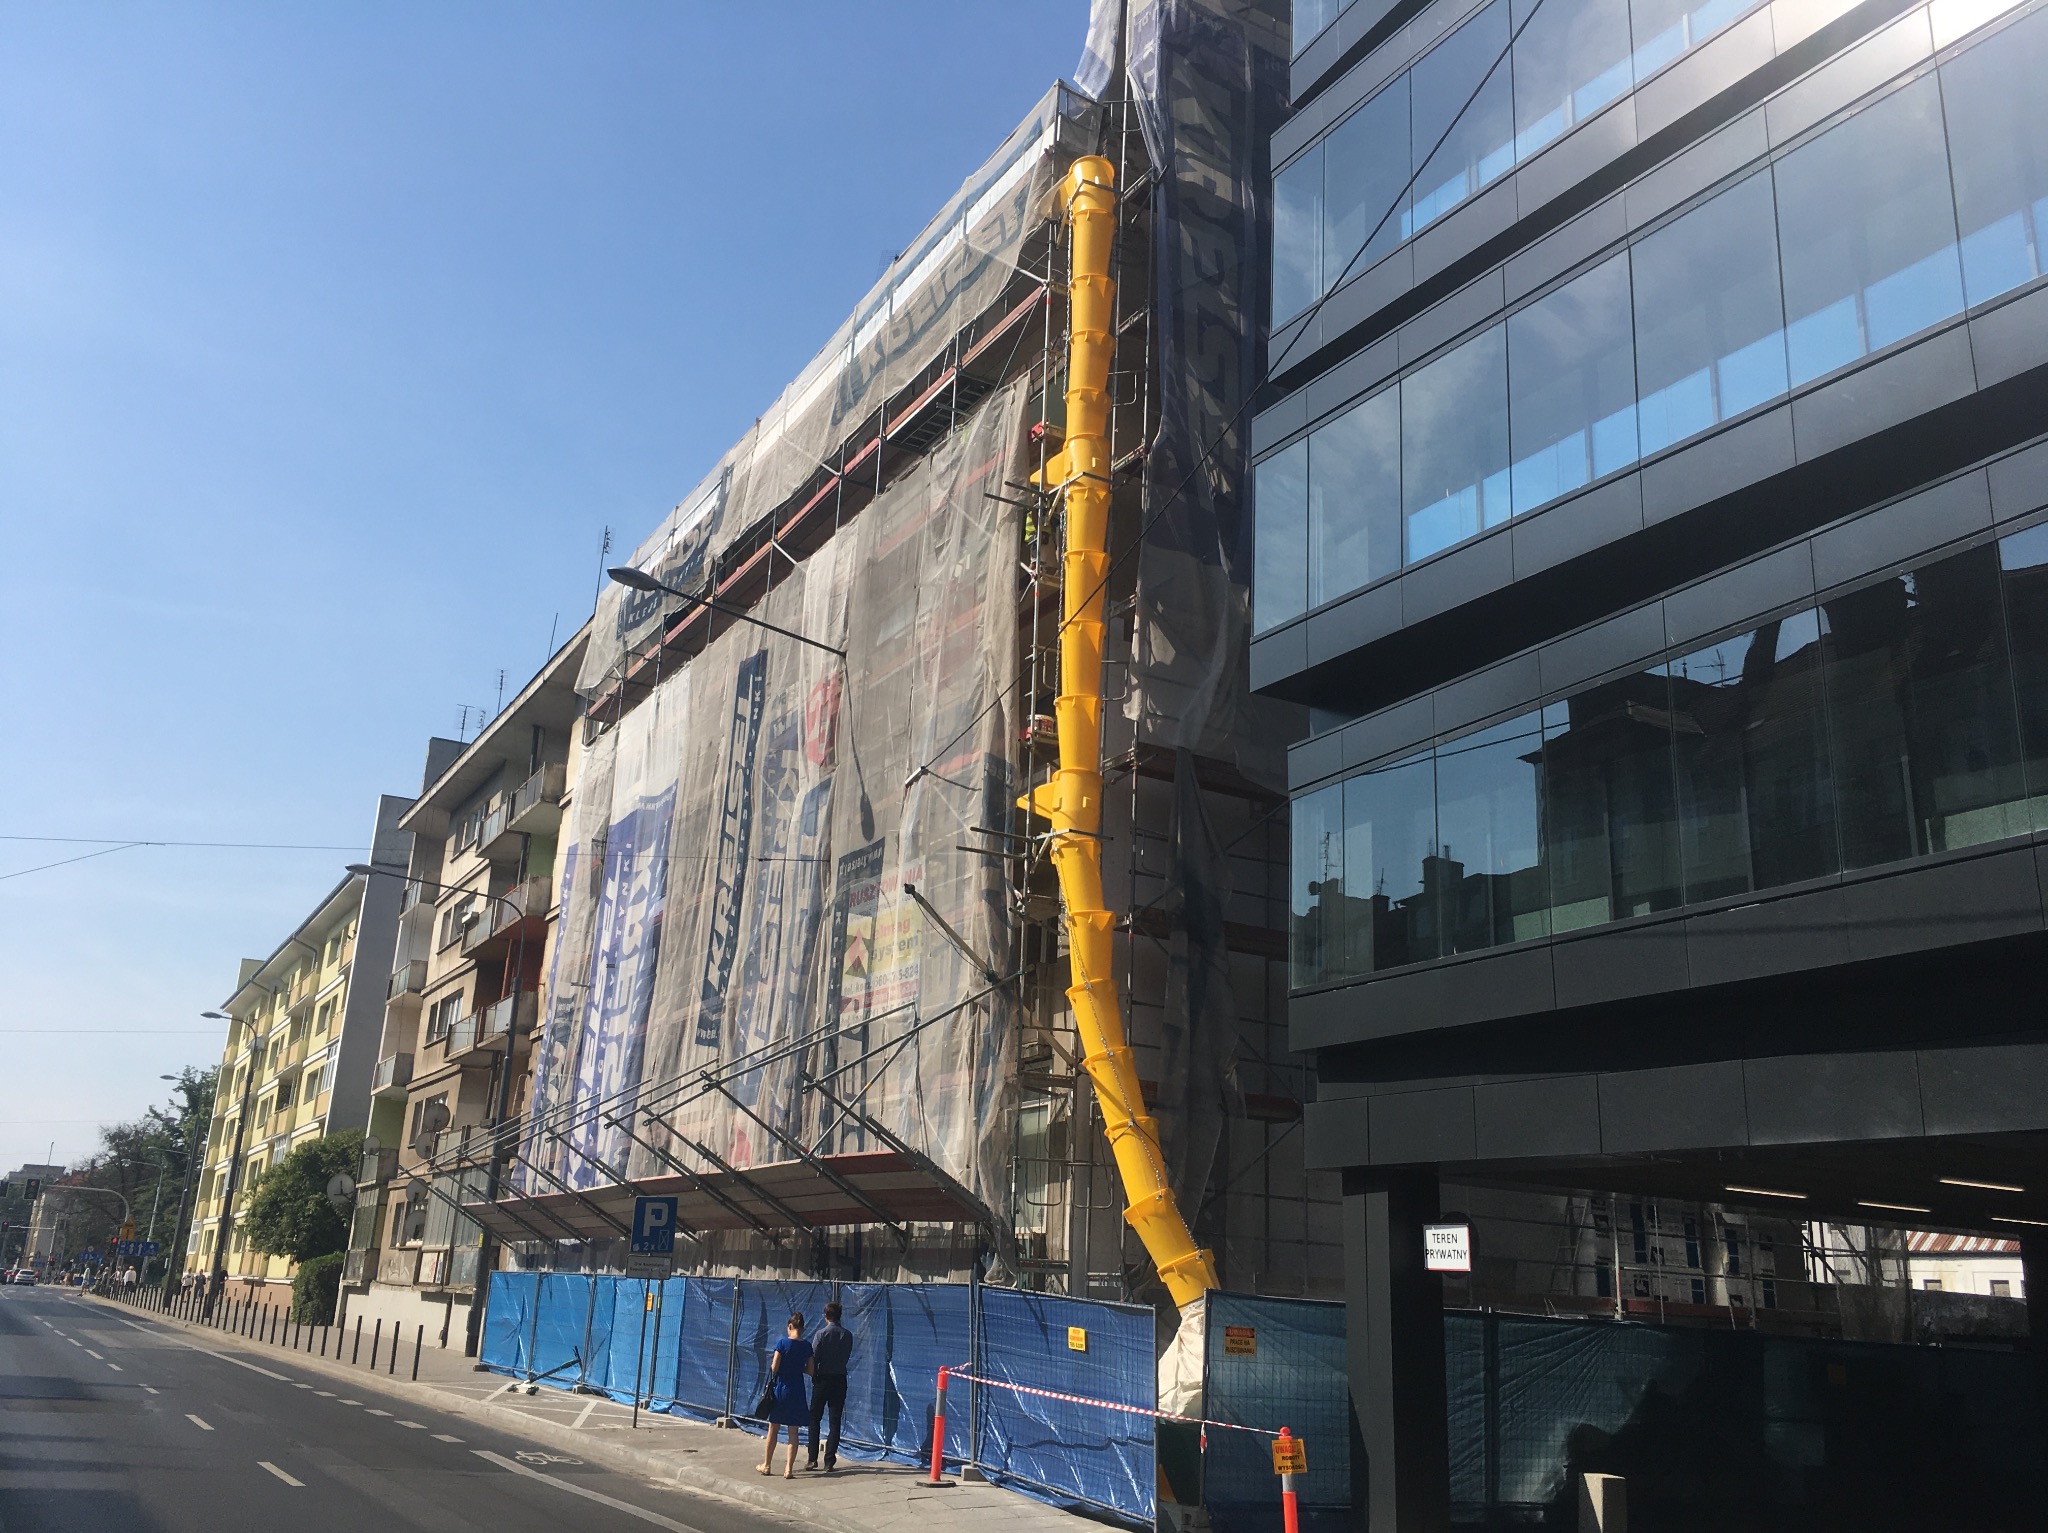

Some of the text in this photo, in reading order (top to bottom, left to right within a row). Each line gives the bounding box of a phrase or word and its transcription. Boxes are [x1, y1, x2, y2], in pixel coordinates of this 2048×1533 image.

[627, 596, 659, 624] KLEJE
[706, 674, 754, 992] KREISEL
[615, 843, 631, 938] TYNKI
[567, 851, 623, 1190] KREISEL
[643, 1203, 669, 1237] P
[1425, 1248, 1468, 1259] PRYWATNY
[1432, 1233, 1458, 1243] TEREN
